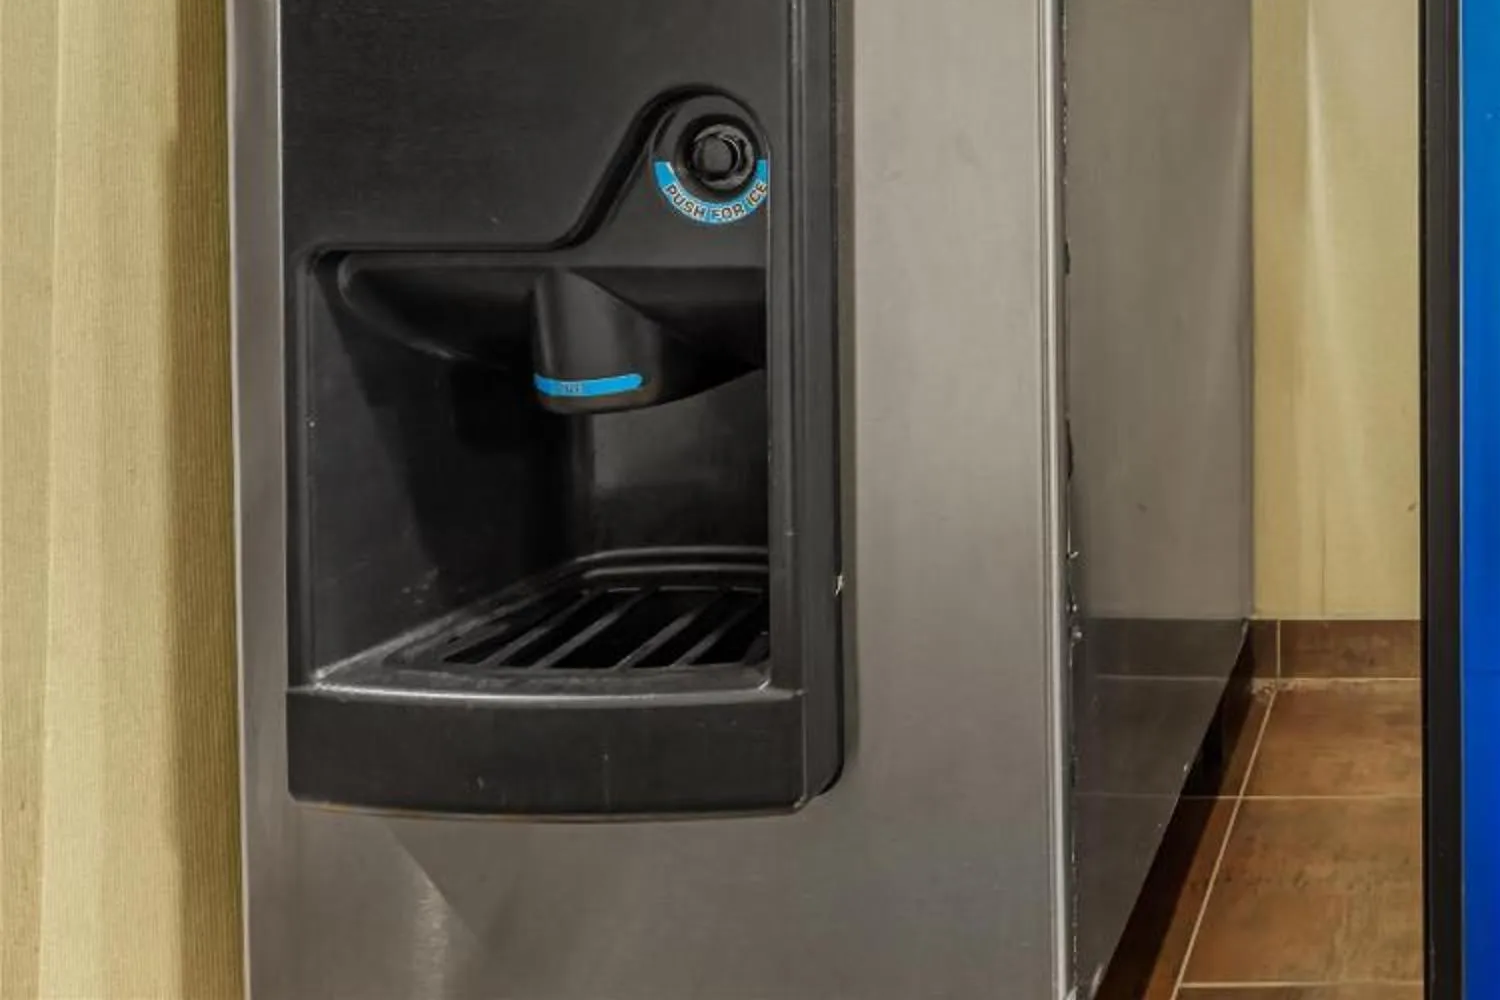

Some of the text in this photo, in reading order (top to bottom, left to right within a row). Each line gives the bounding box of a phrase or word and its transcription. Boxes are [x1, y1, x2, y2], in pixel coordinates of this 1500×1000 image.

[665, 182, 768, 219] PUSH FOR ICE
